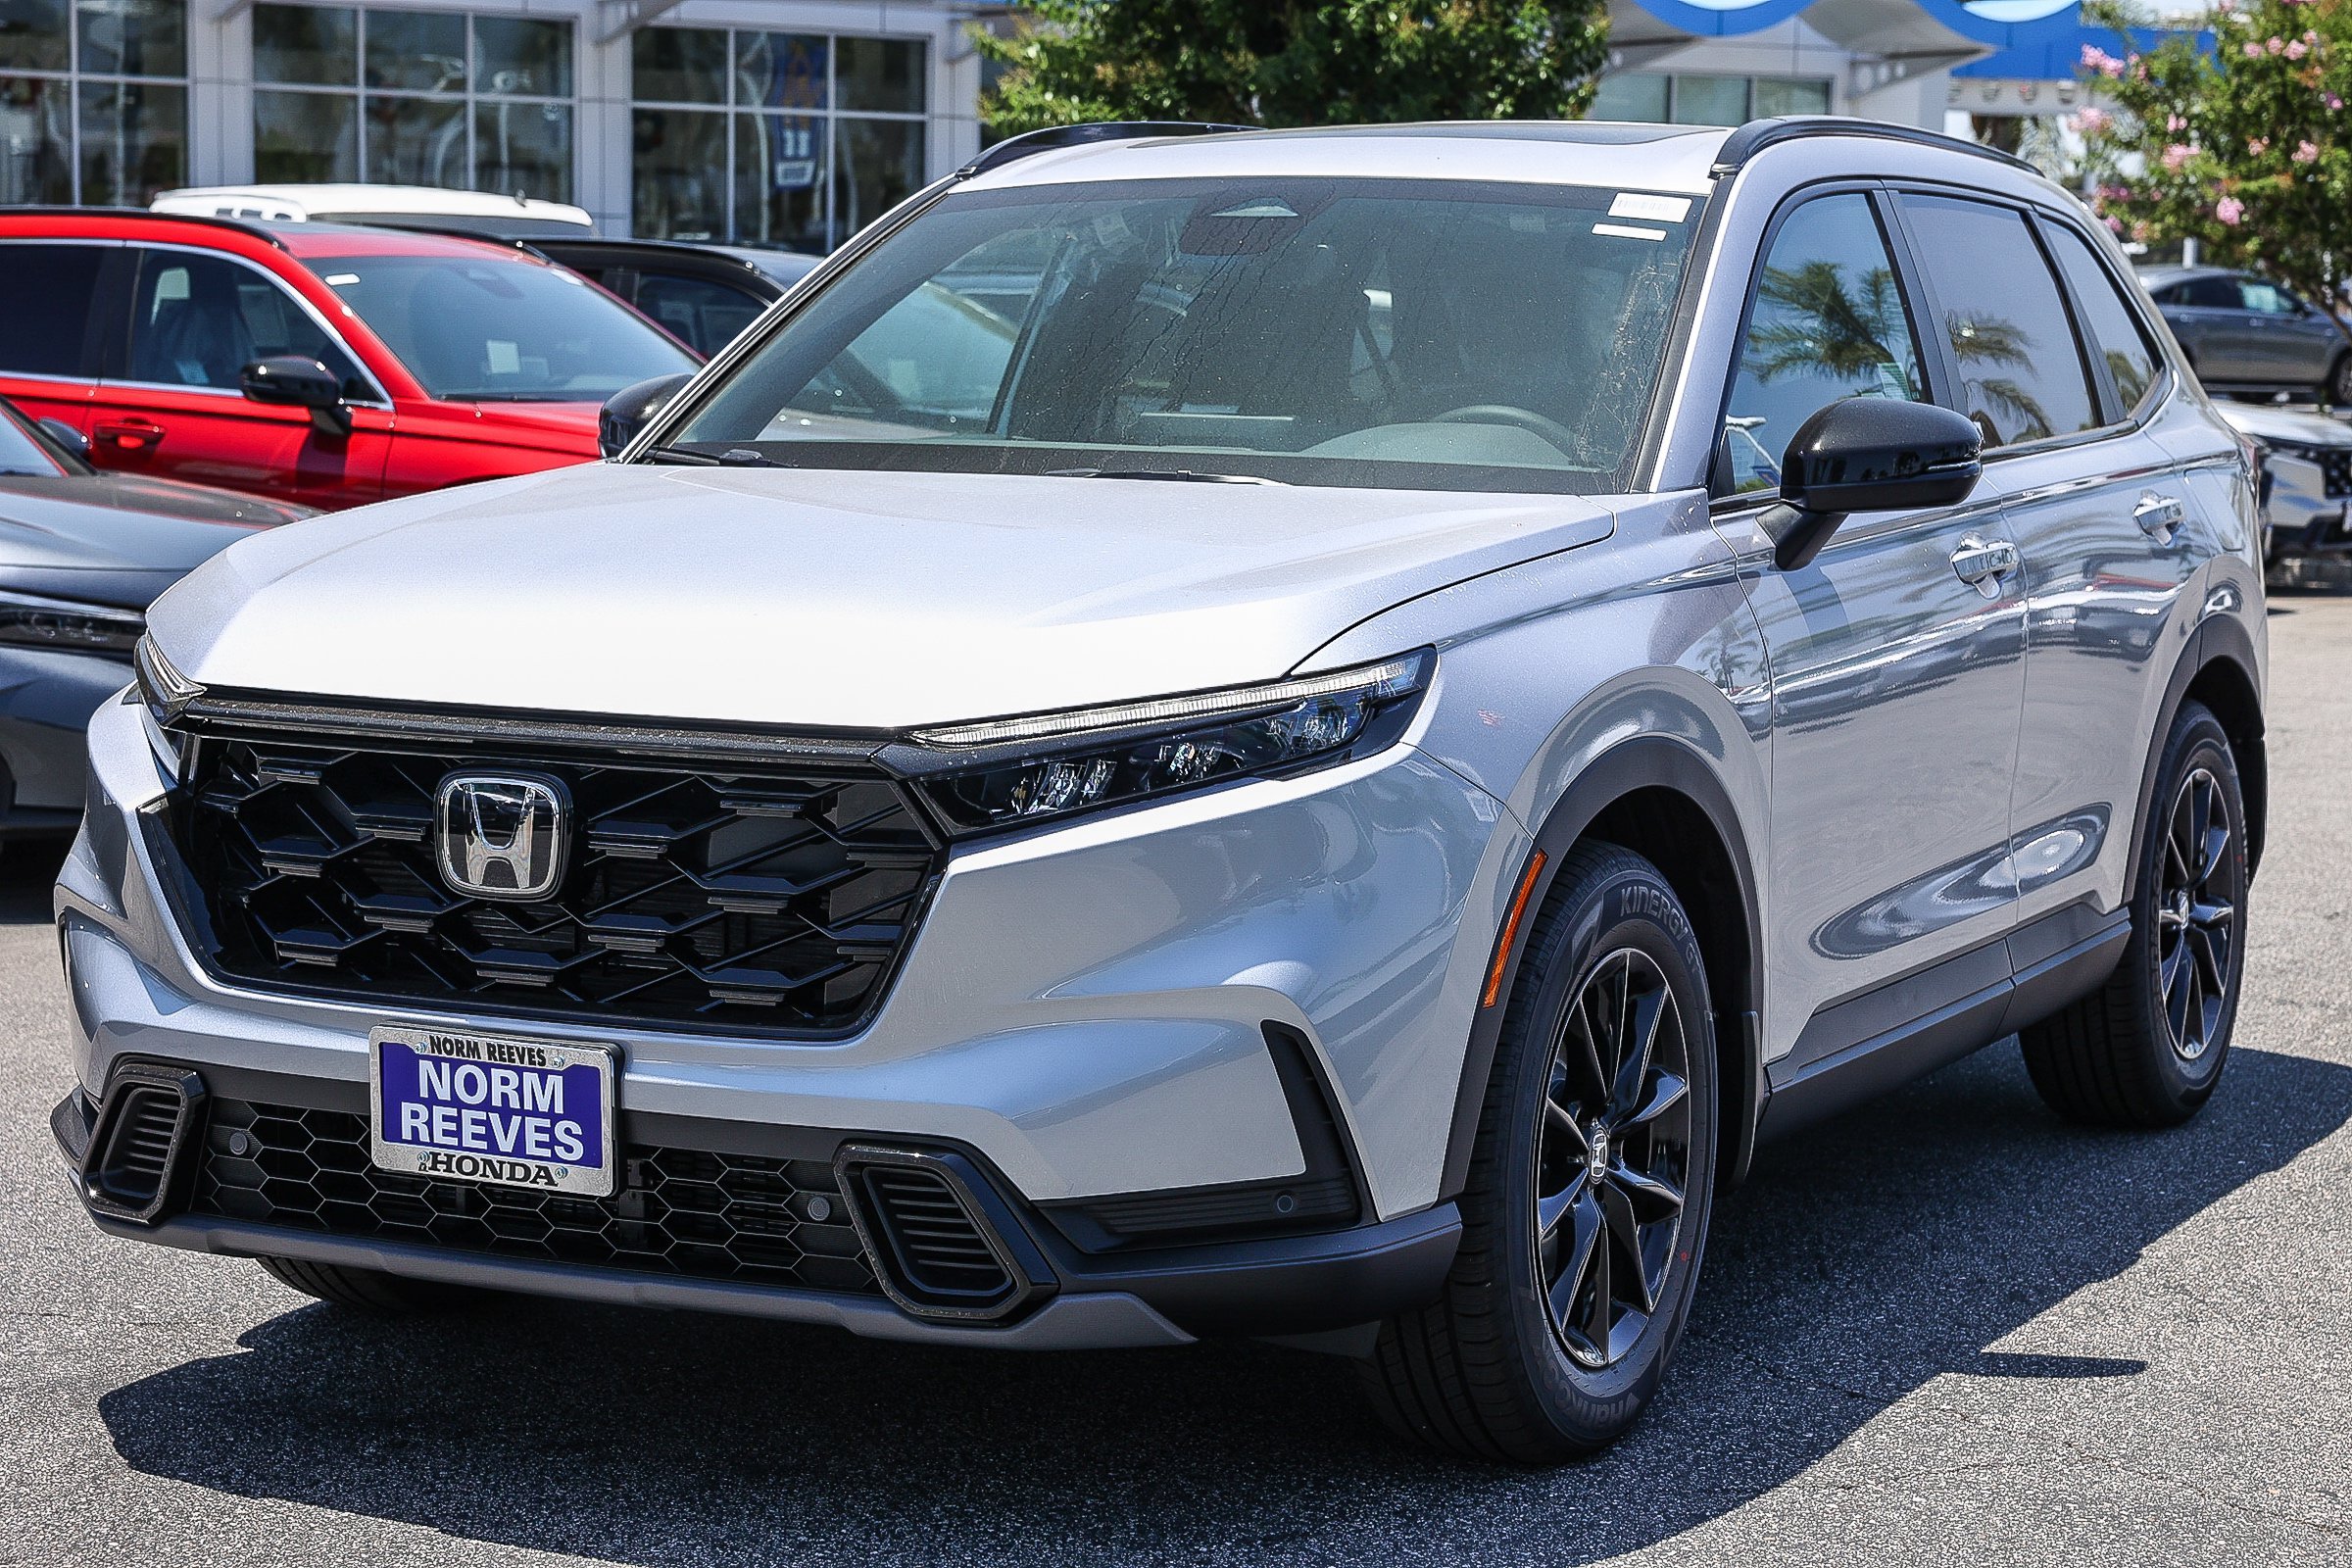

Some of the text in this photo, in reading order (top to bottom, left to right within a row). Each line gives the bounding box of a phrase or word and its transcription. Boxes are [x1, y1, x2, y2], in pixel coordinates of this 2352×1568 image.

[429, 1035, 547, 1067] NORM REEVES
[418, 1059, 564, 1114] NORM
[401, 1102, 585, 1161] REEVES
[427, 1151, 560, 1188] HONDA
